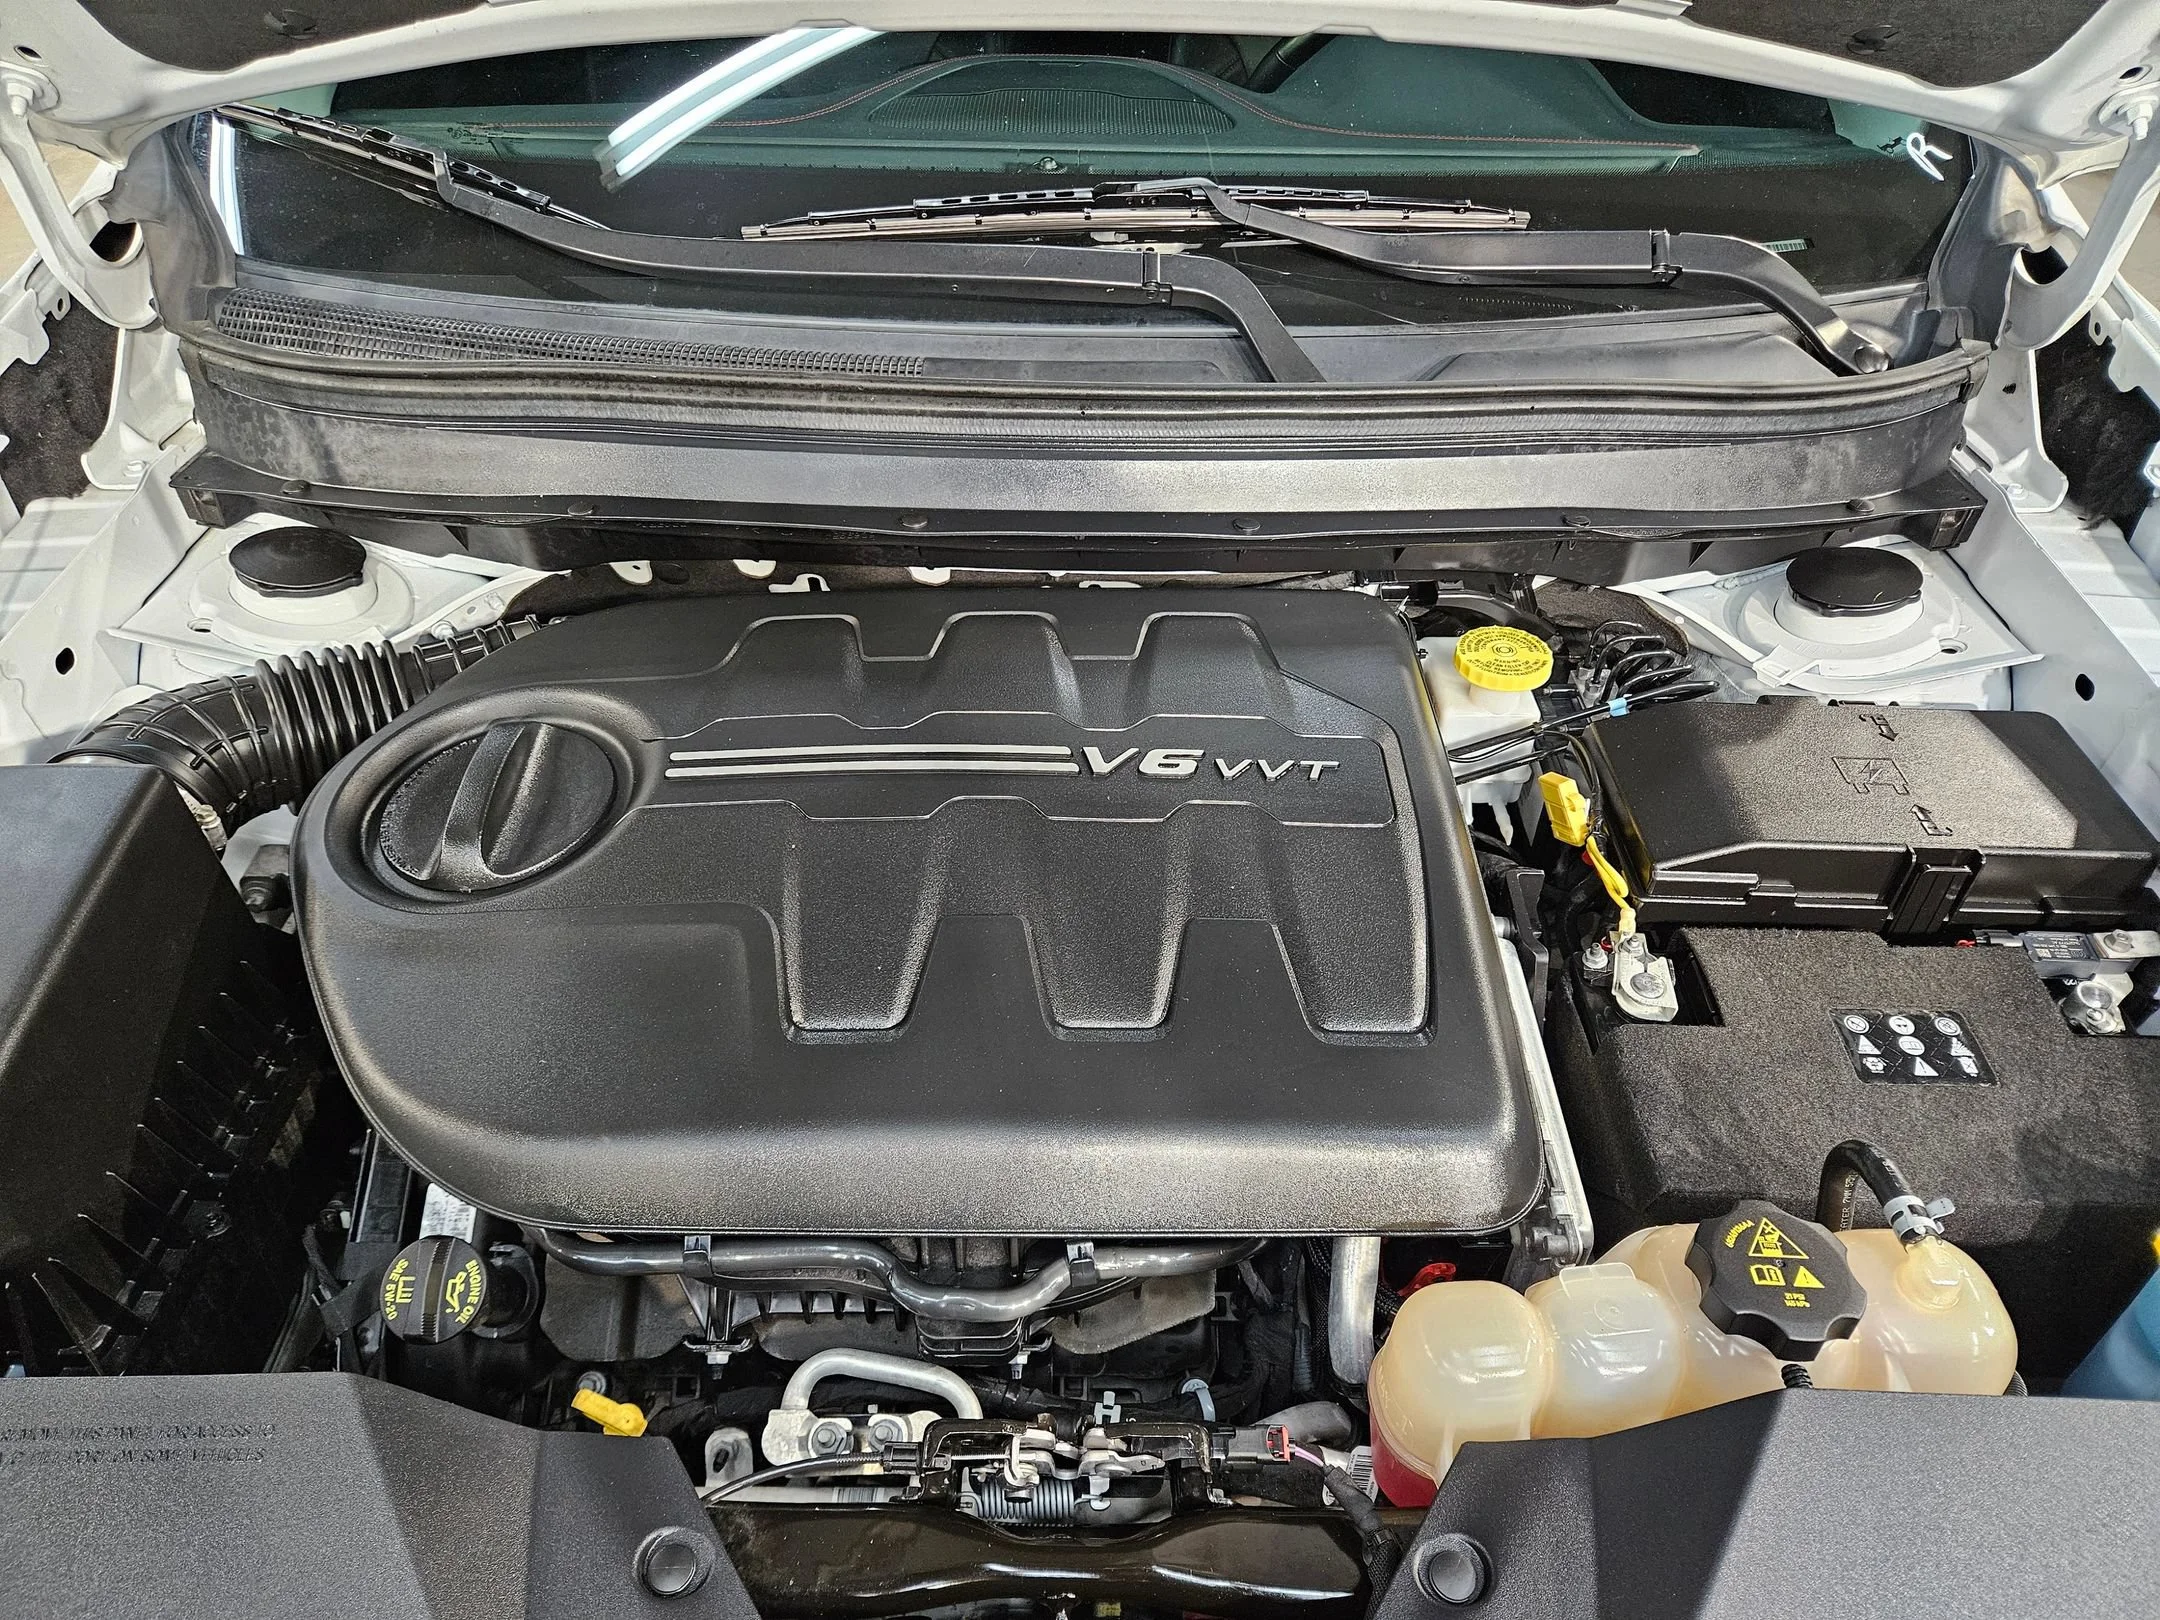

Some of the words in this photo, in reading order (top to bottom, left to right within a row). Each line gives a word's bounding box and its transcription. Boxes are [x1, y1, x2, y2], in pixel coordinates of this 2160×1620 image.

[1906, 132, 1954, 182] R
[1081, 746, 1206, 779] V6
[1214, 758, 1341, 782] VVT
[389, 1259, 409, 1281] SAE
[465, 1259, 482, 1304] ENGINE
[384, 1283, 398, 1320] 5W-20
[455, 1305, 475, 1324] OIL
